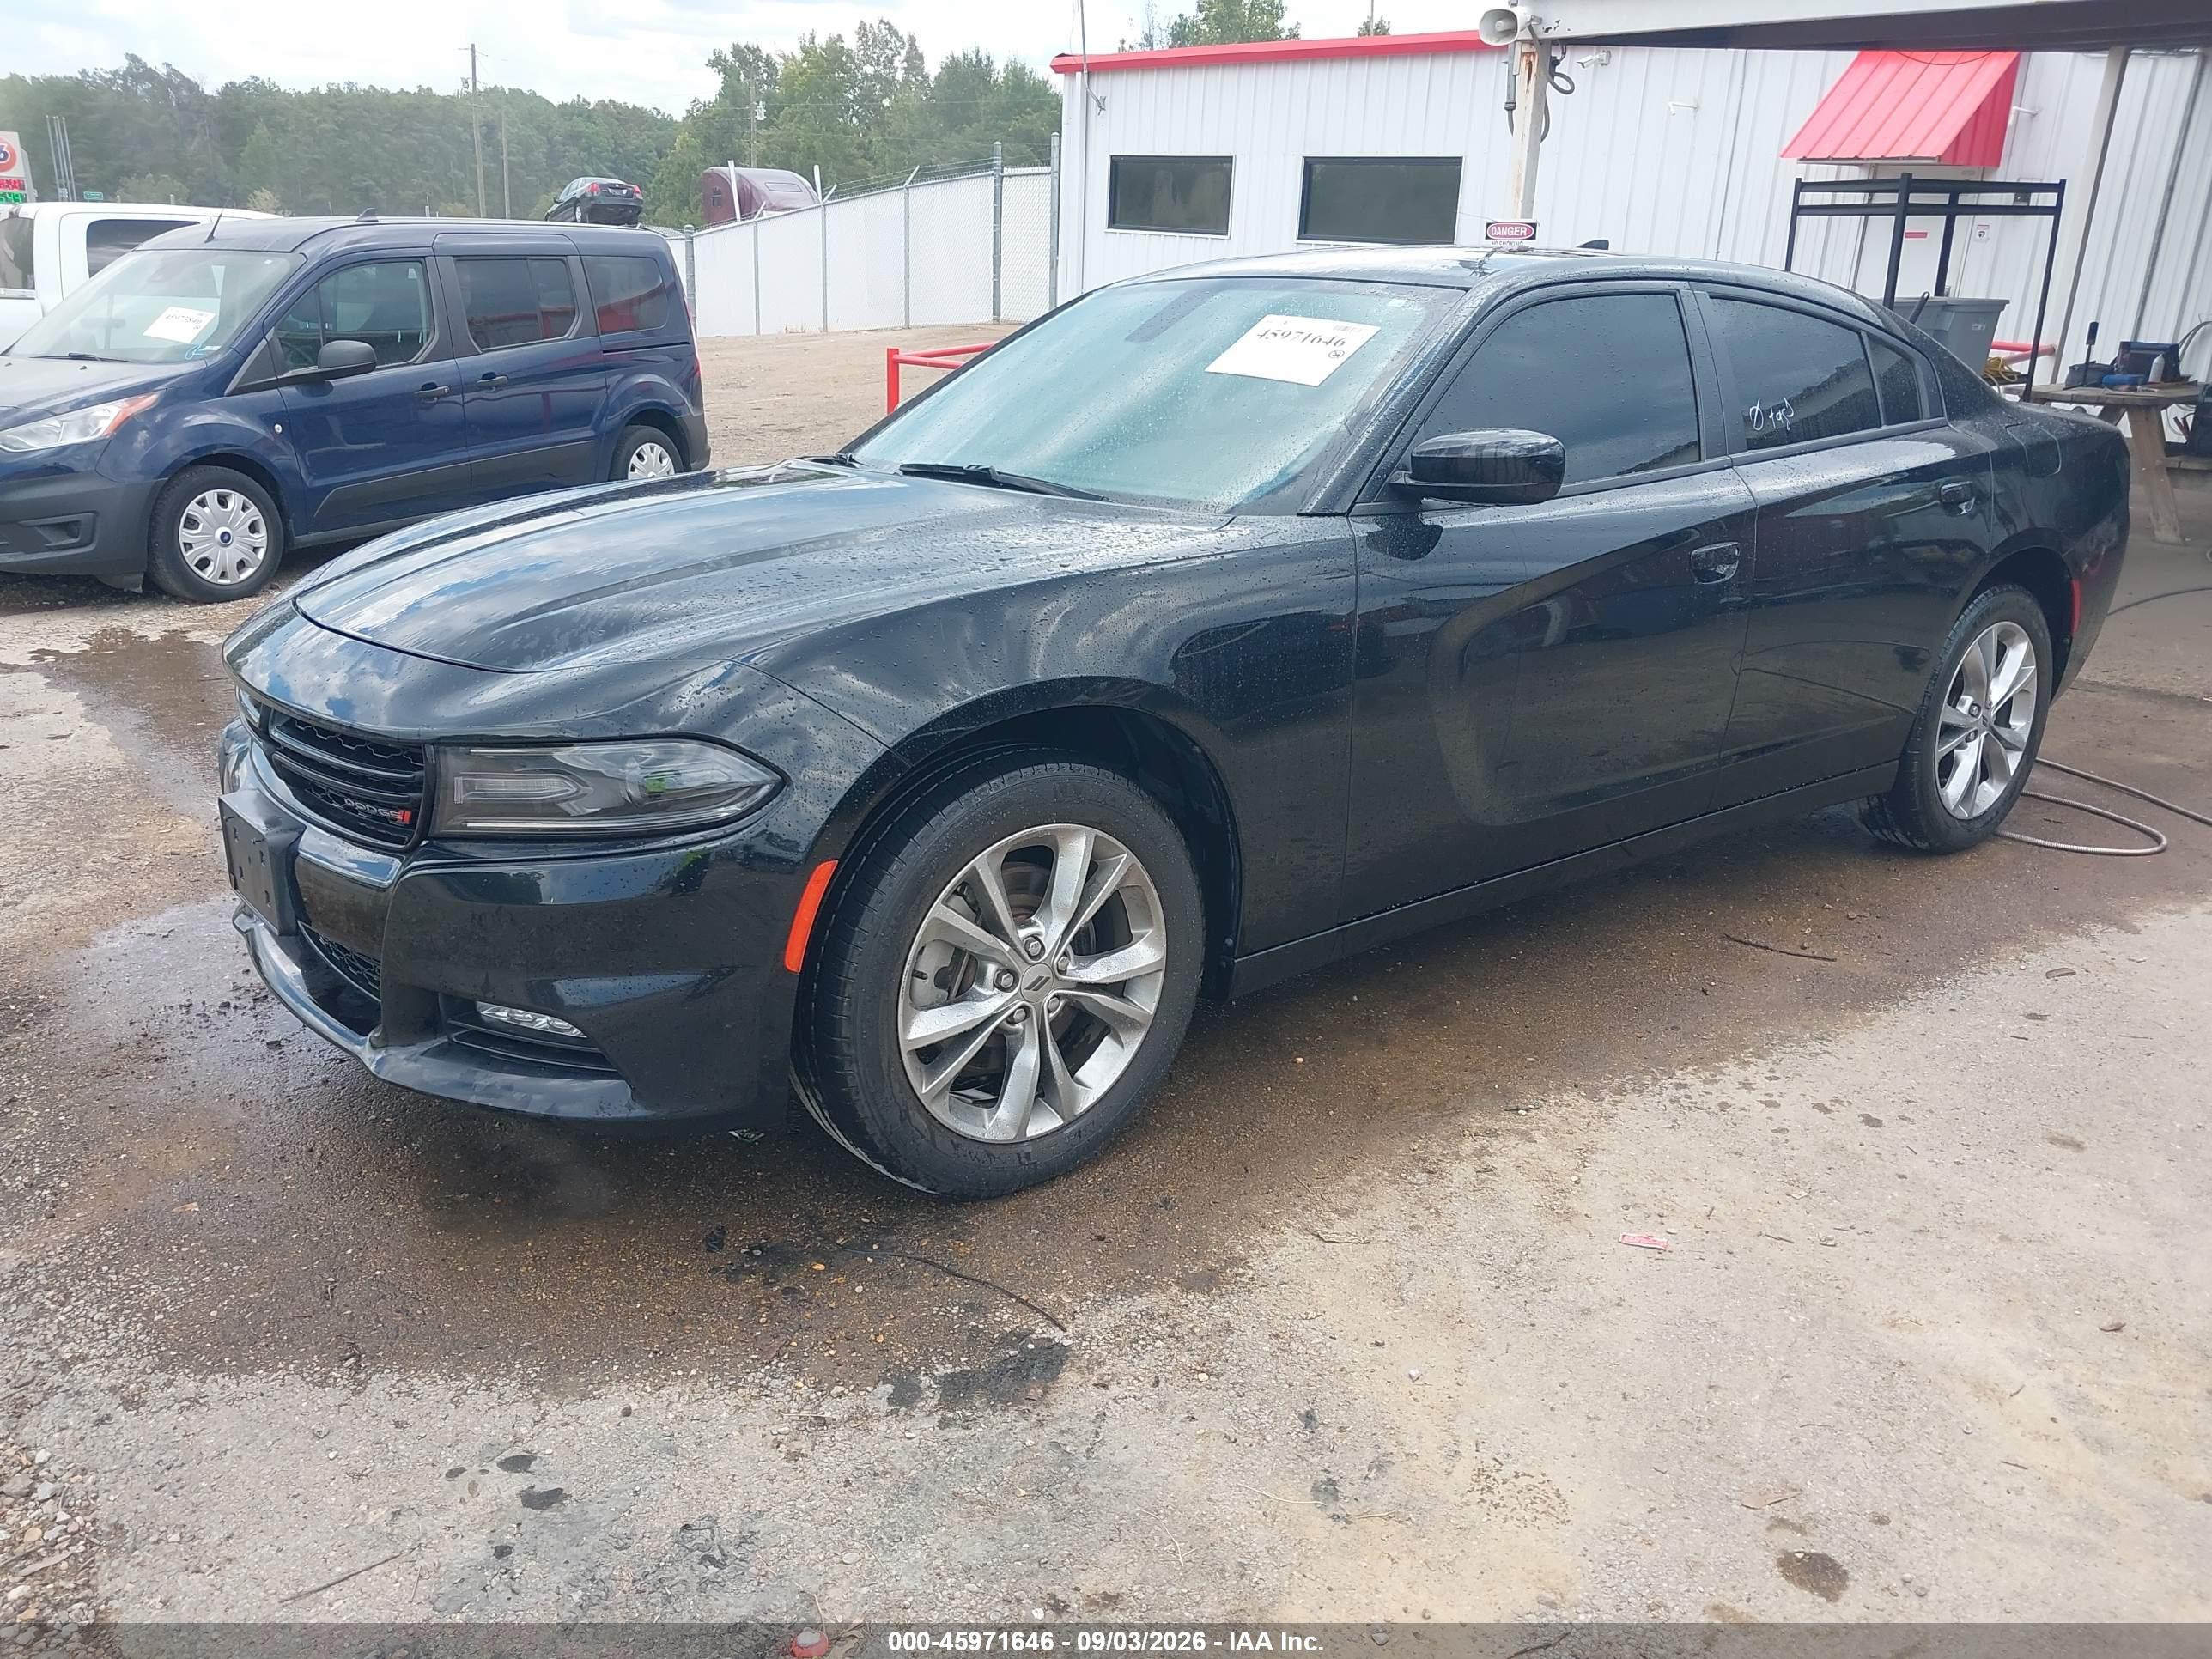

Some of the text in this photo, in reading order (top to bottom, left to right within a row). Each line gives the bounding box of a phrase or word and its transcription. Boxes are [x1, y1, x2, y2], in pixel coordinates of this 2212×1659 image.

[0, 143, 10, 163] 6
[1491, 226, 1528, 236] DANGER
[1257, 329, 1346, 348] 45971646
[343, 798, 403, 820] DODGE
